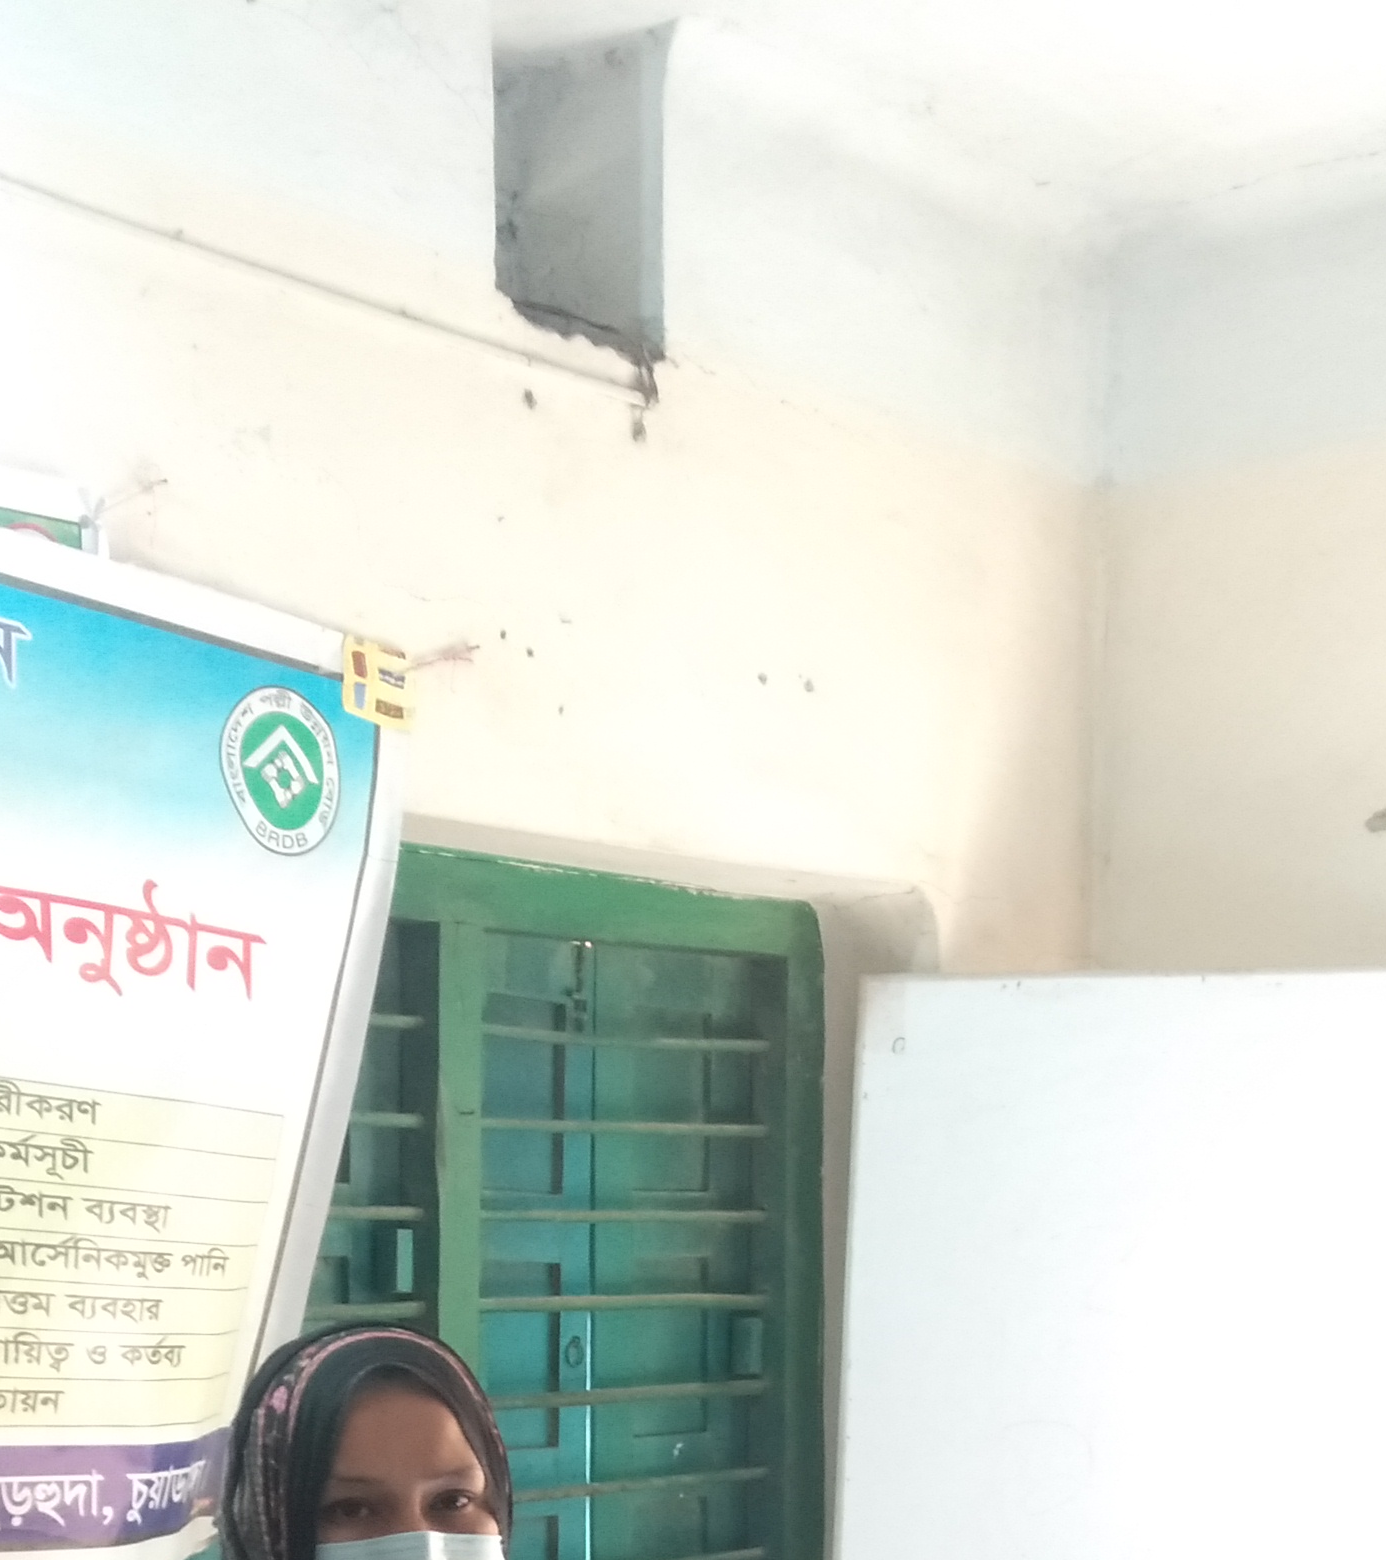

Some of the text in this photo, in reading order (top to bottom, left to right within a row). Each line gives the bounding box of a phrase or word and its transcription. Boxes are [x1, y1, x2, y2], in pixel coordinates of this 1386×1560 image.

[255, 821, 308, 849] BRDB
[82, 1198, 172, 1232] ব্যবস্থা
[181, 1247, 230, 1278] পানি
[64, 1294, 162, 1322] ব্যবহার
[86, 1345, 107, 1365] ও
[119, 1336, 186, 1368] কর্তব্য
